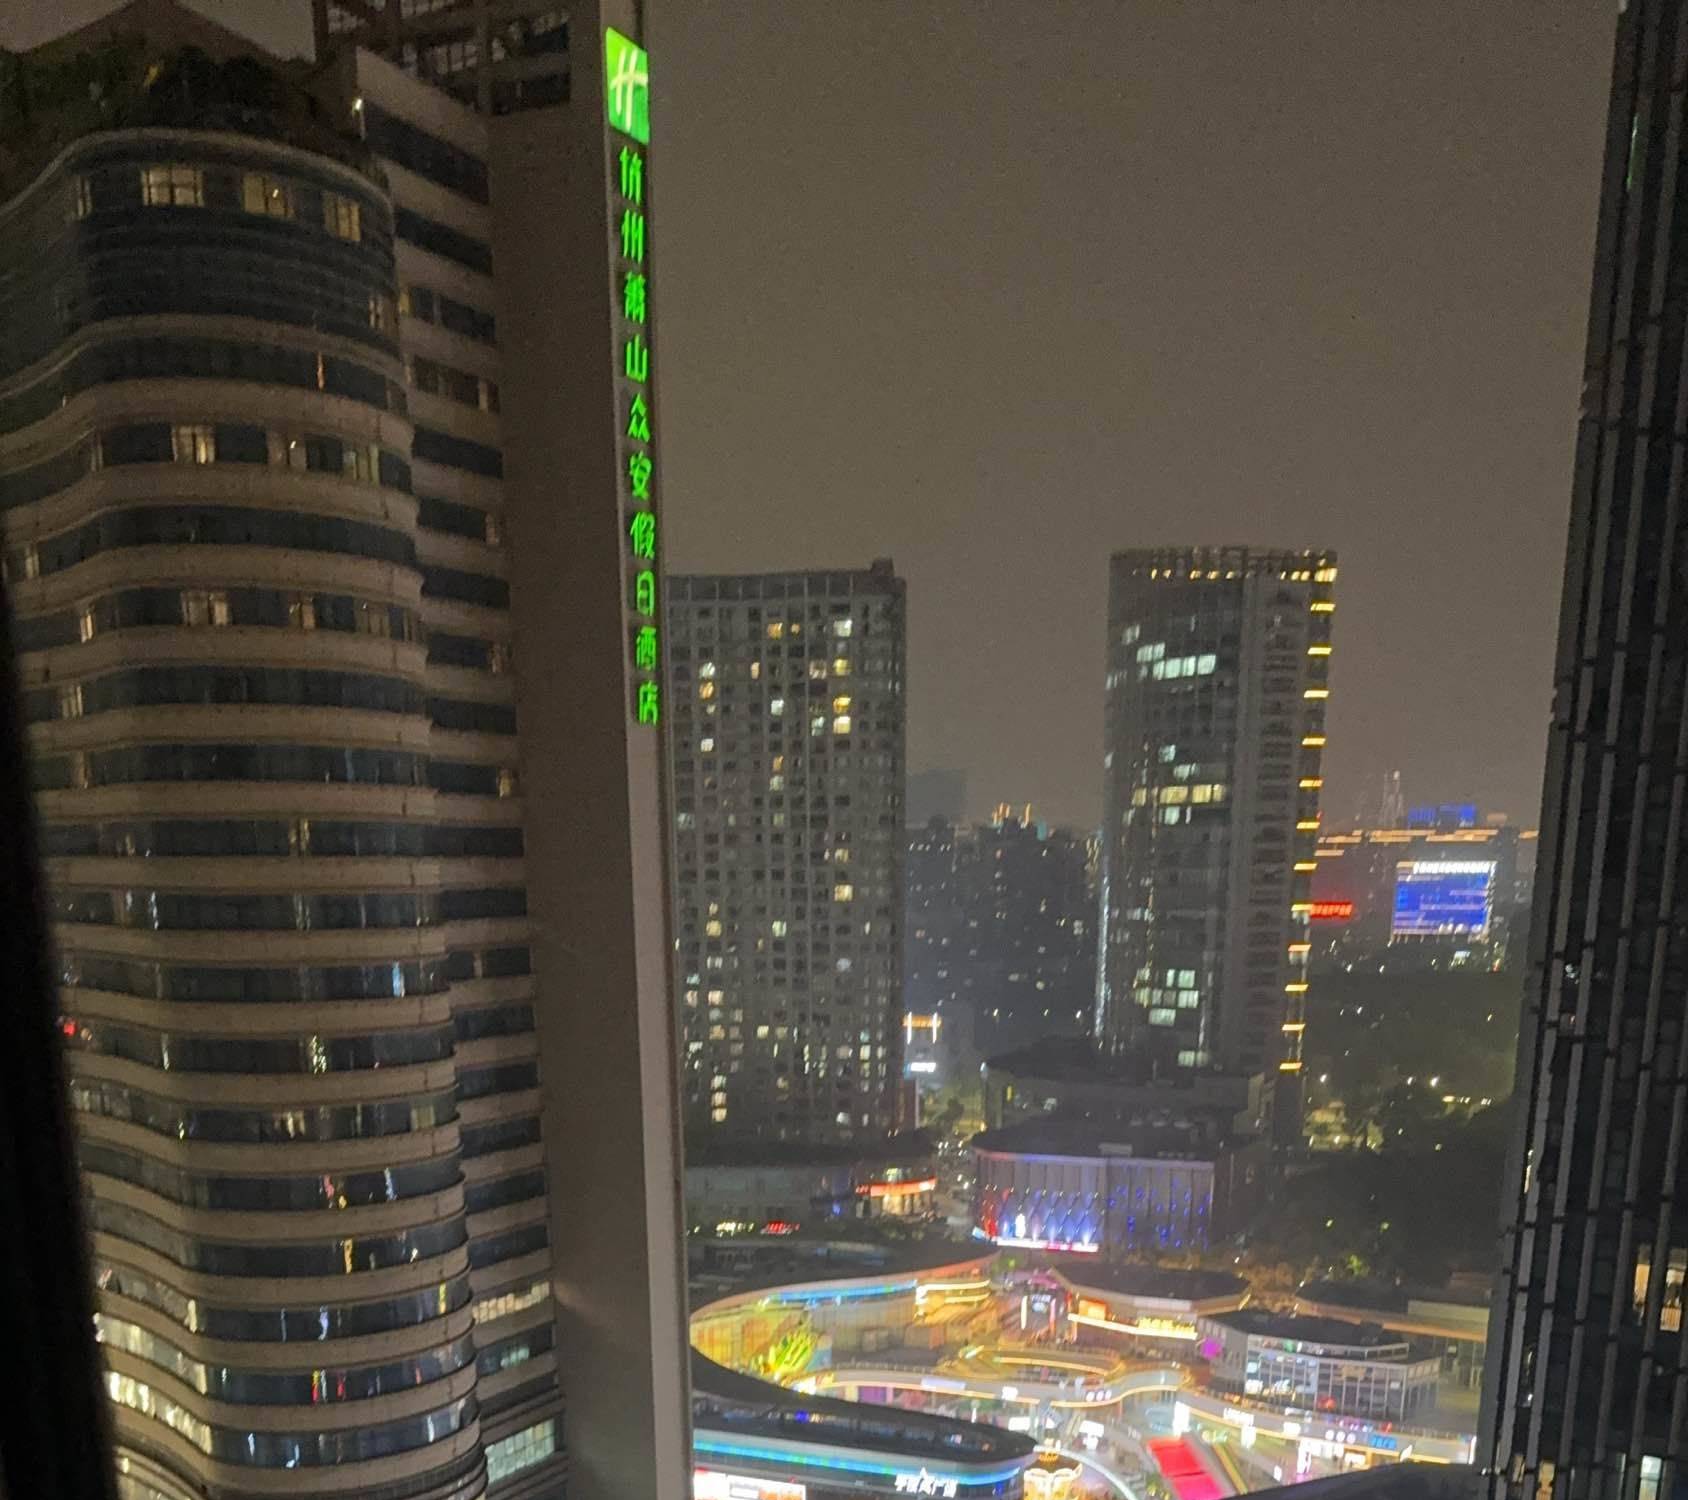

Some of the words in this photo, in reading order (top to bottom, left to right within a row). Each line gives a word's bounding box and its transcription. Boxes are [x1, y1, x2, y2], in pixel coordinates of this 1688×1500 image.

[619, 145, 658, 726] 杭州萧山众安假日酒店
